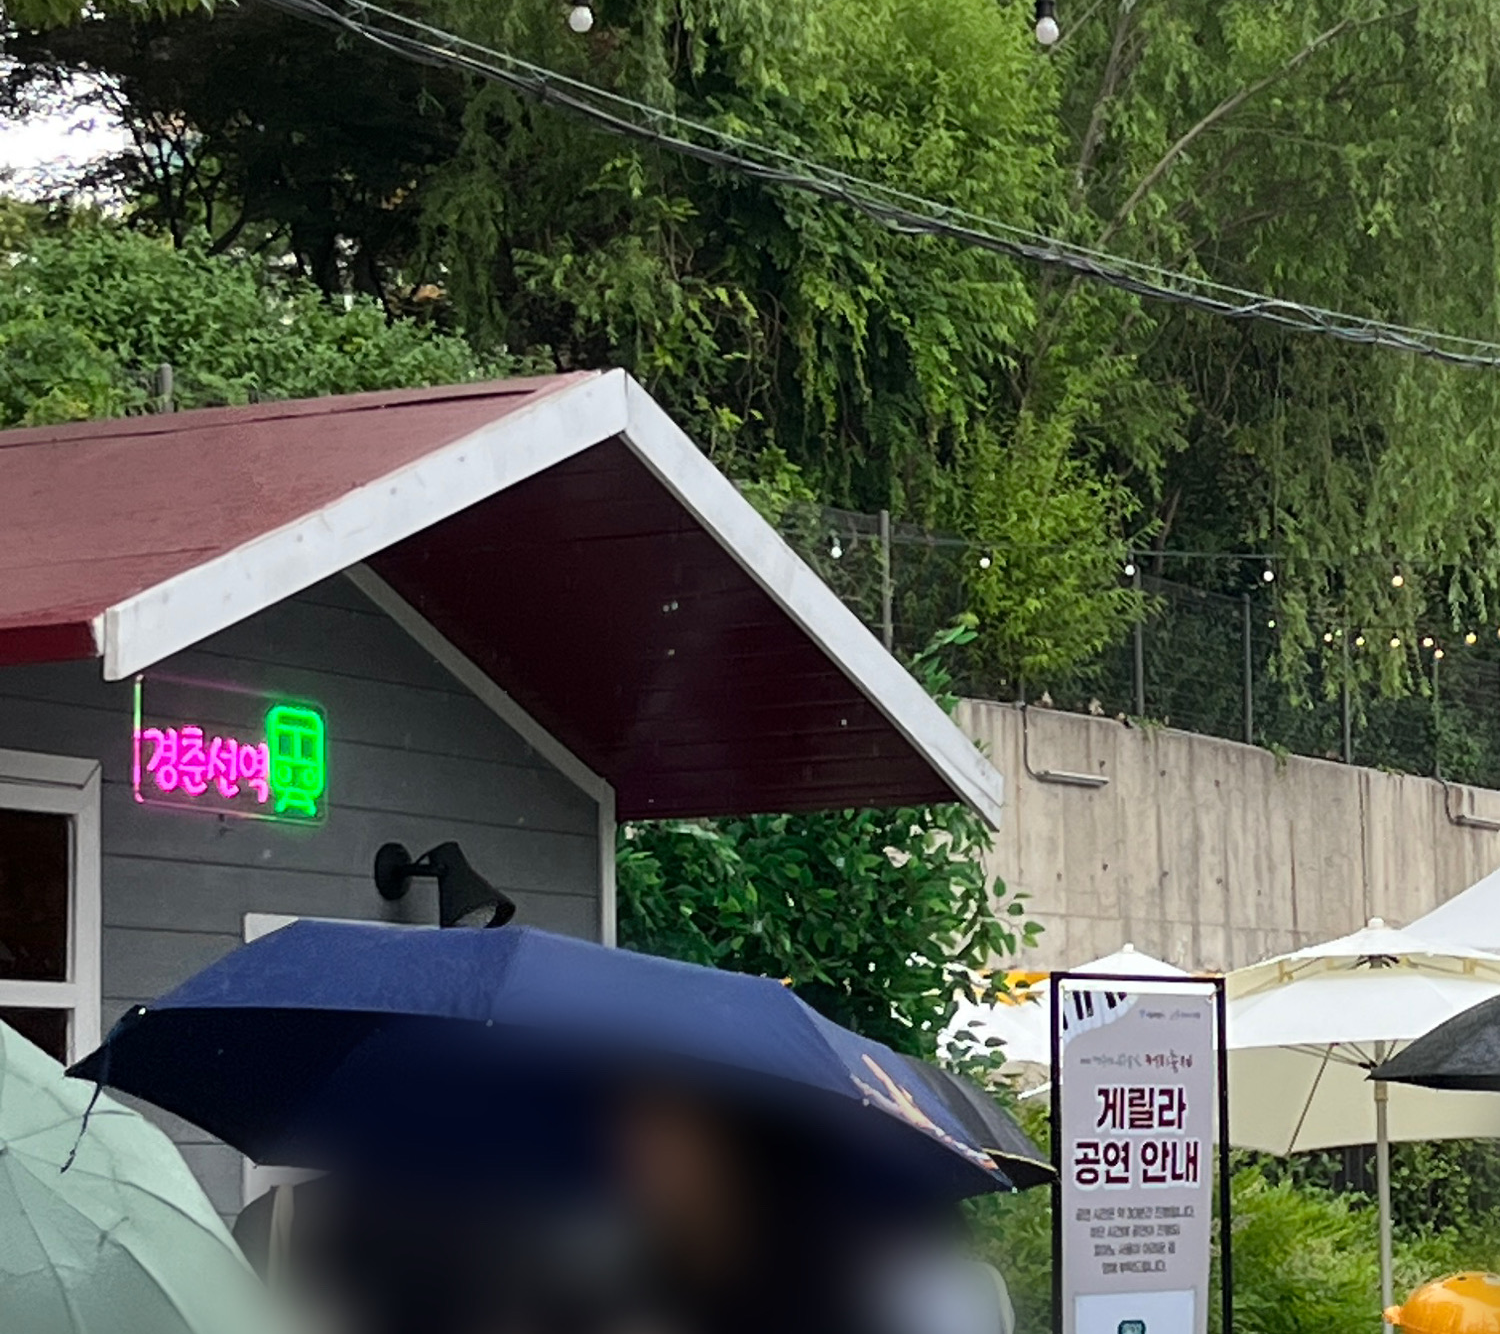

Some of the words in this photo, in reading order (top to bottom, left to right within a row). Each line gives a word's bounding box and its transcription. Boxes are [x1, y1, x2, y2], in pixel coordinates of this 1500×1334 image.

[143, 725, 269, 803] 경춘선역
[1097, 1087, 1187, 1130] 게릴라
[1074, 1141, 1130, 1186] 공연
[1140, 1141, 1199, 1184] 안내
